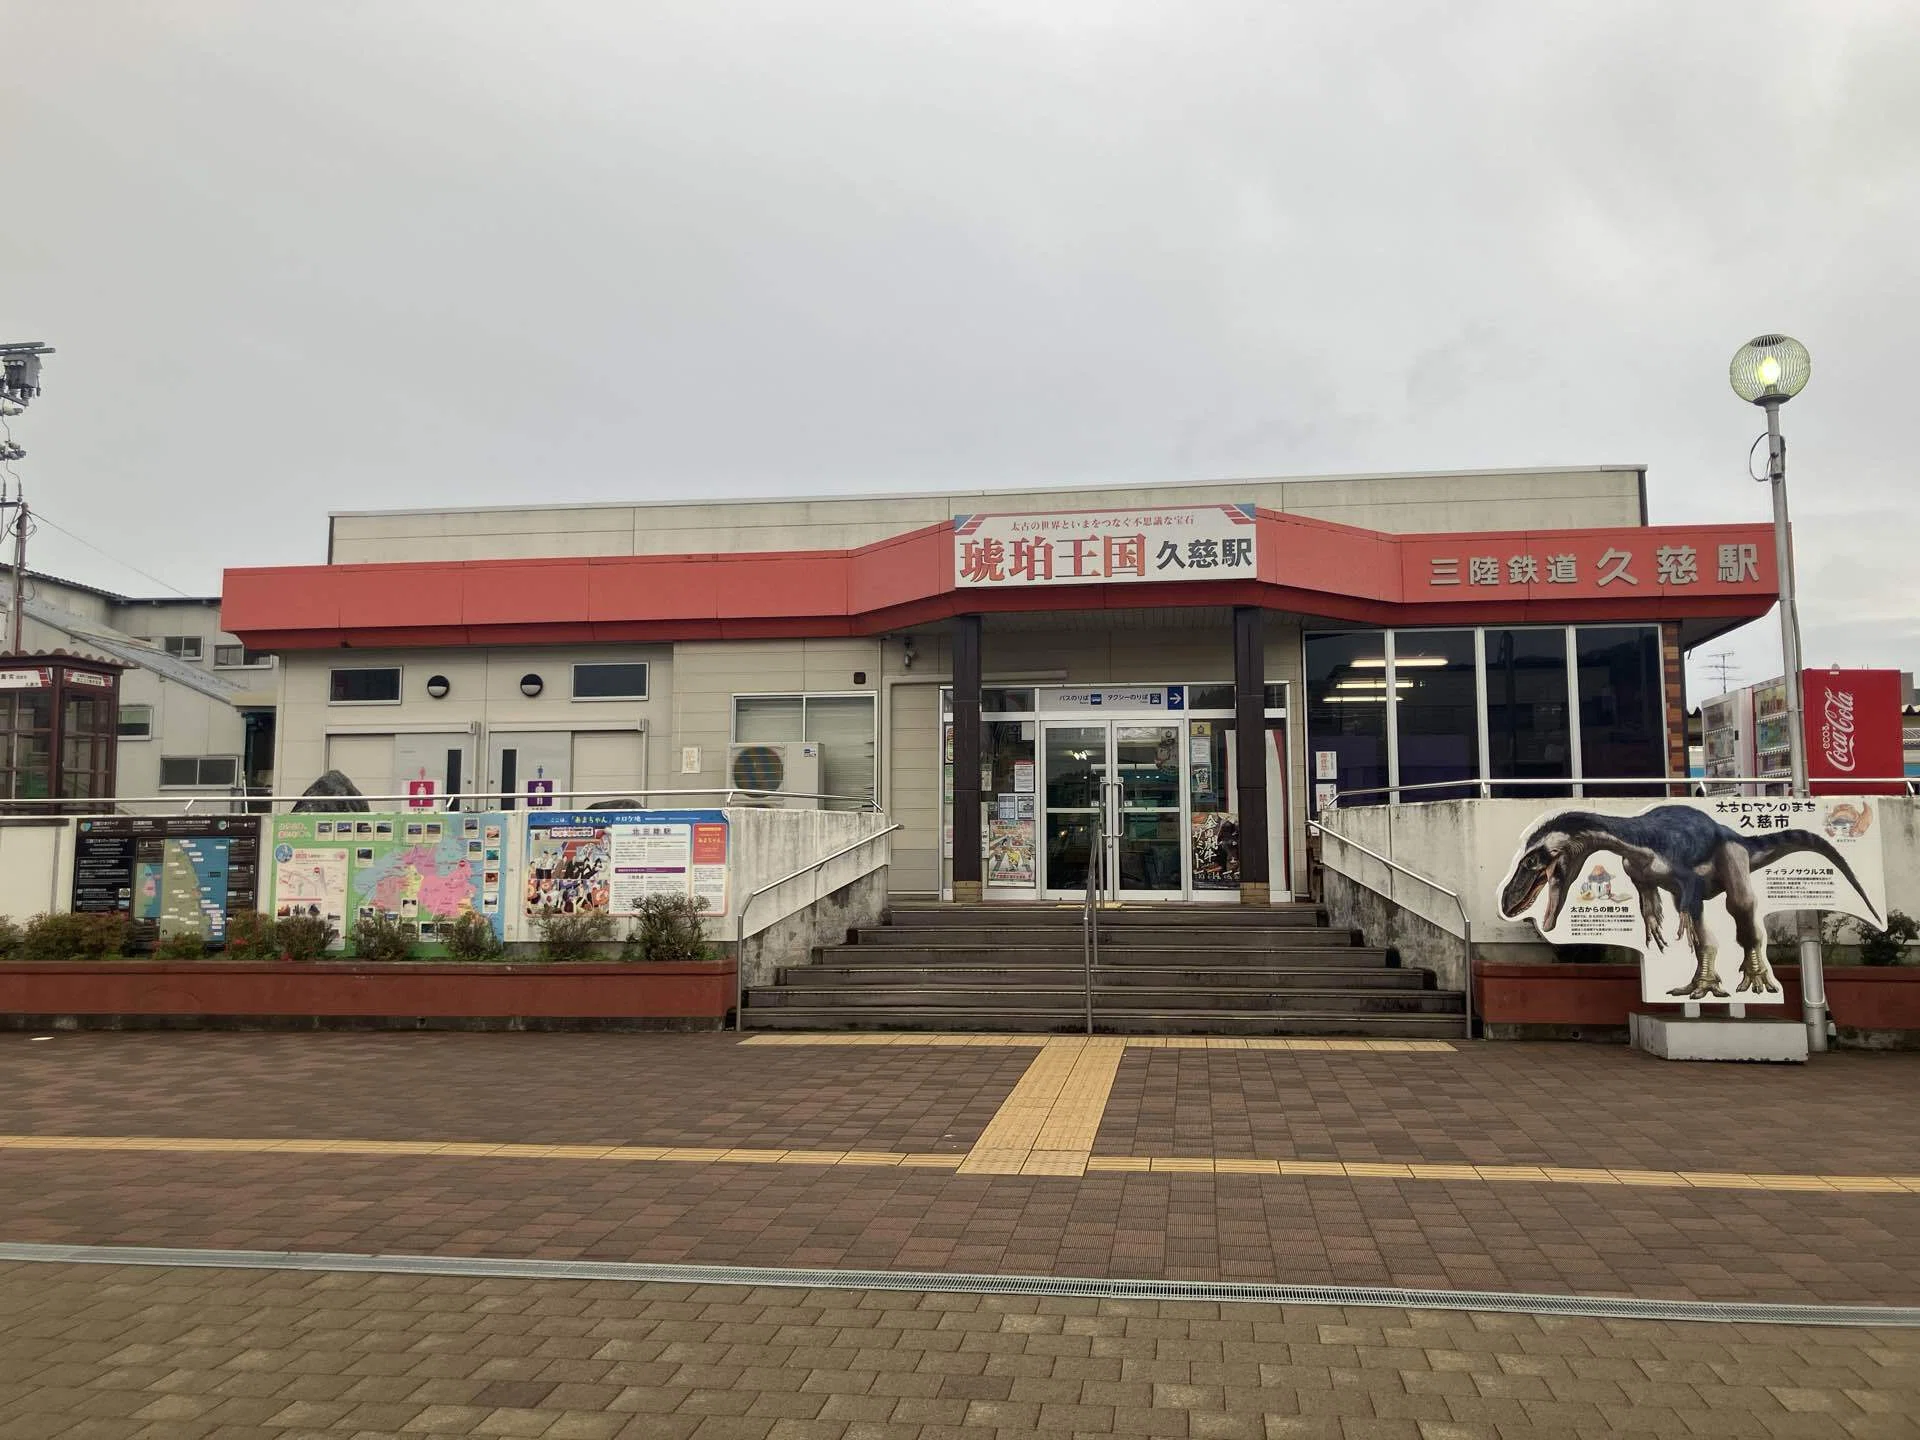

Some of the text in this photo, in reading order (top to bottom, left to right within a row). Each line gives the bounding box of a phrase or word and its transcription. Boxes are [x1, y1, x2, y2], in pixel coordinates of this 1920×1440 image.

[1010, 514, 1194, 532] 太古の世界といまをつなぐ不思議な宝石
[959, 533, 1253, 582] 琥珀王国 久慈駅
[1429, 543, 1760, 587] 三陸鉄道 久慈駅
[1825, 686, 1856, 772] Coca-Cola
[1715, 801, 1816, 813] 太古ロマンのまち
[1739, 814, 1790, 830] 久慈市
[1764, 868, 1834, 876] ティラノサウルス類
